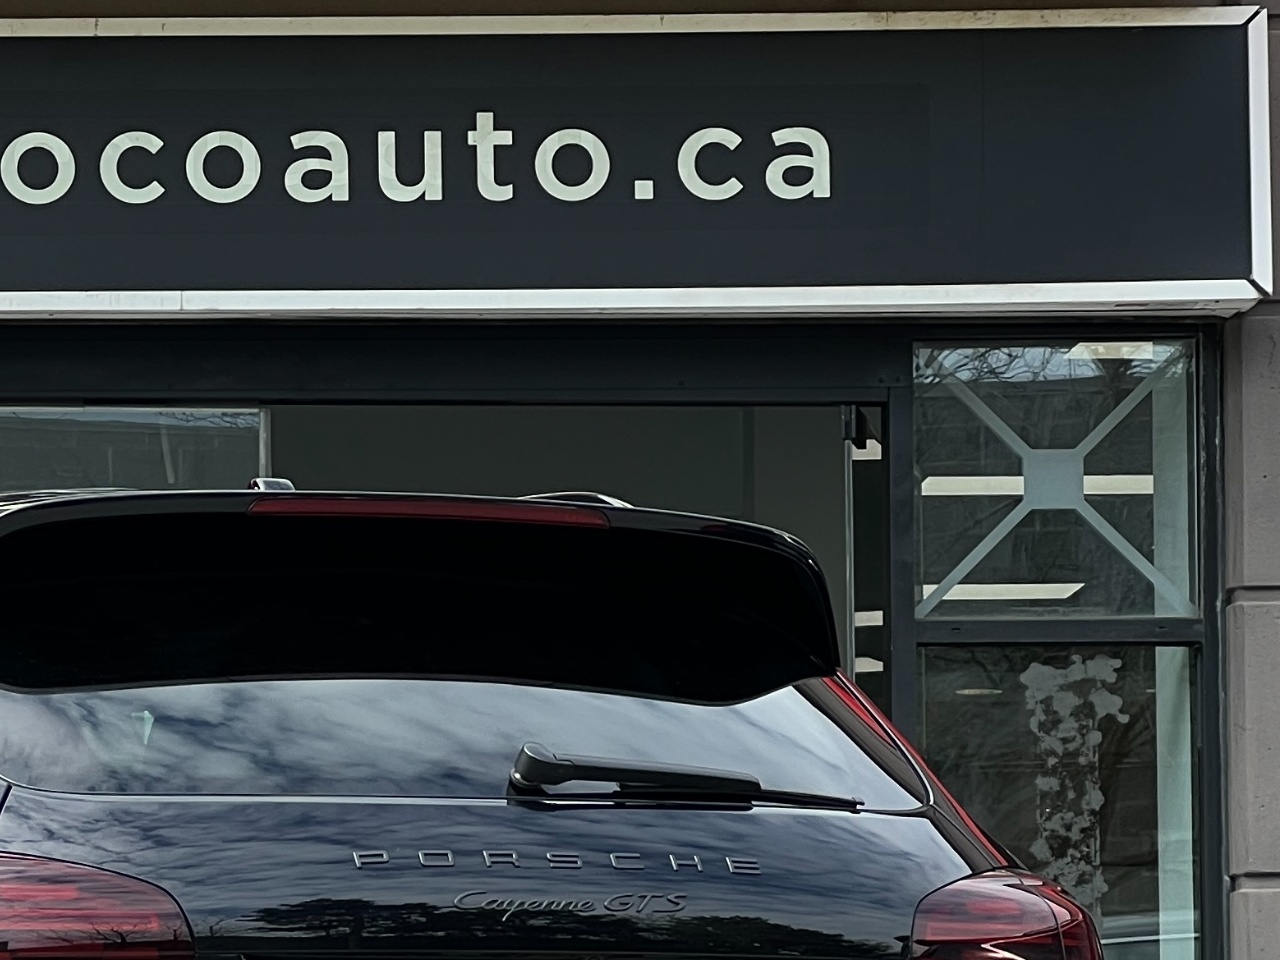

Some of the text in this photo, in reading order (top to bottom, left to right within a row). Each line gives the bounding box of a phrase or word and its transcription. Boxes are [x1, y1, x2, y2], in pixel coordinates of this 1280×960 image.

[352, 849, 763, 875] PORSCHE
[452, 889, 689, 922] Cayenne GTS
